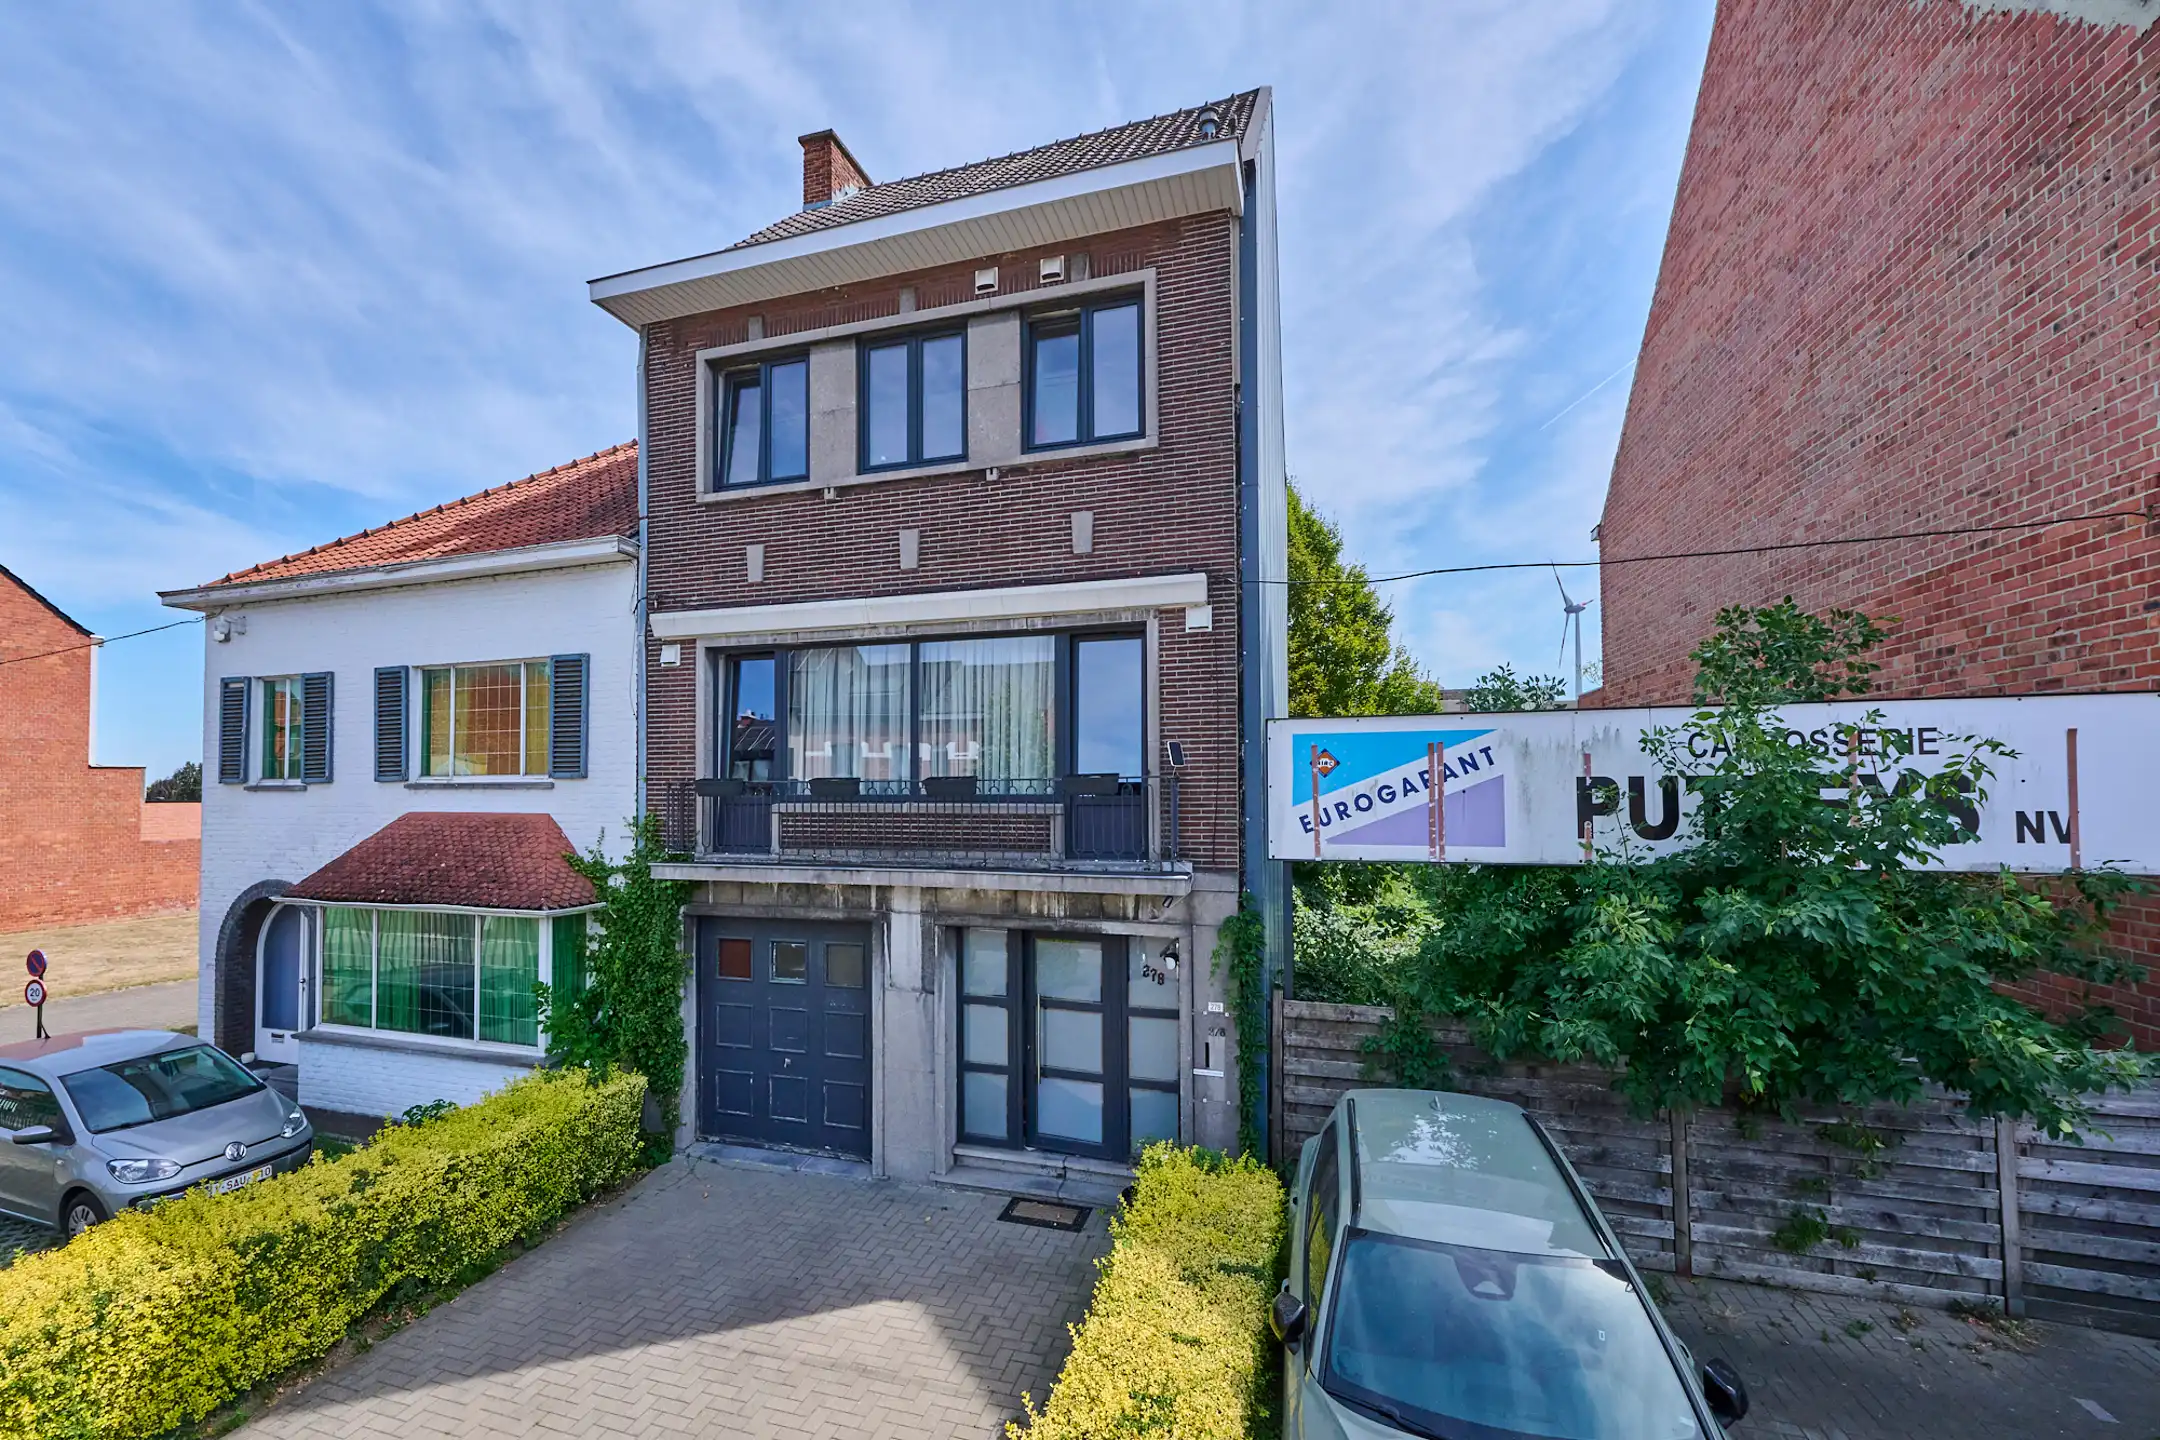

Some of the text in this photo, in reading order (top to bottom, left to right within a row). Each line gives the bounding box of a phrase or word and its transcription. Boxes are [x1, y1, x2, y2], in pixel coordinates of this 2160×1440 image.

[1688, 727, 1939, 758] CAOSSERIE
[2015, 810, 2072, 844] NV
[1142, 964, 1165, 986] 278
[29, 987, 41, 997] 20
